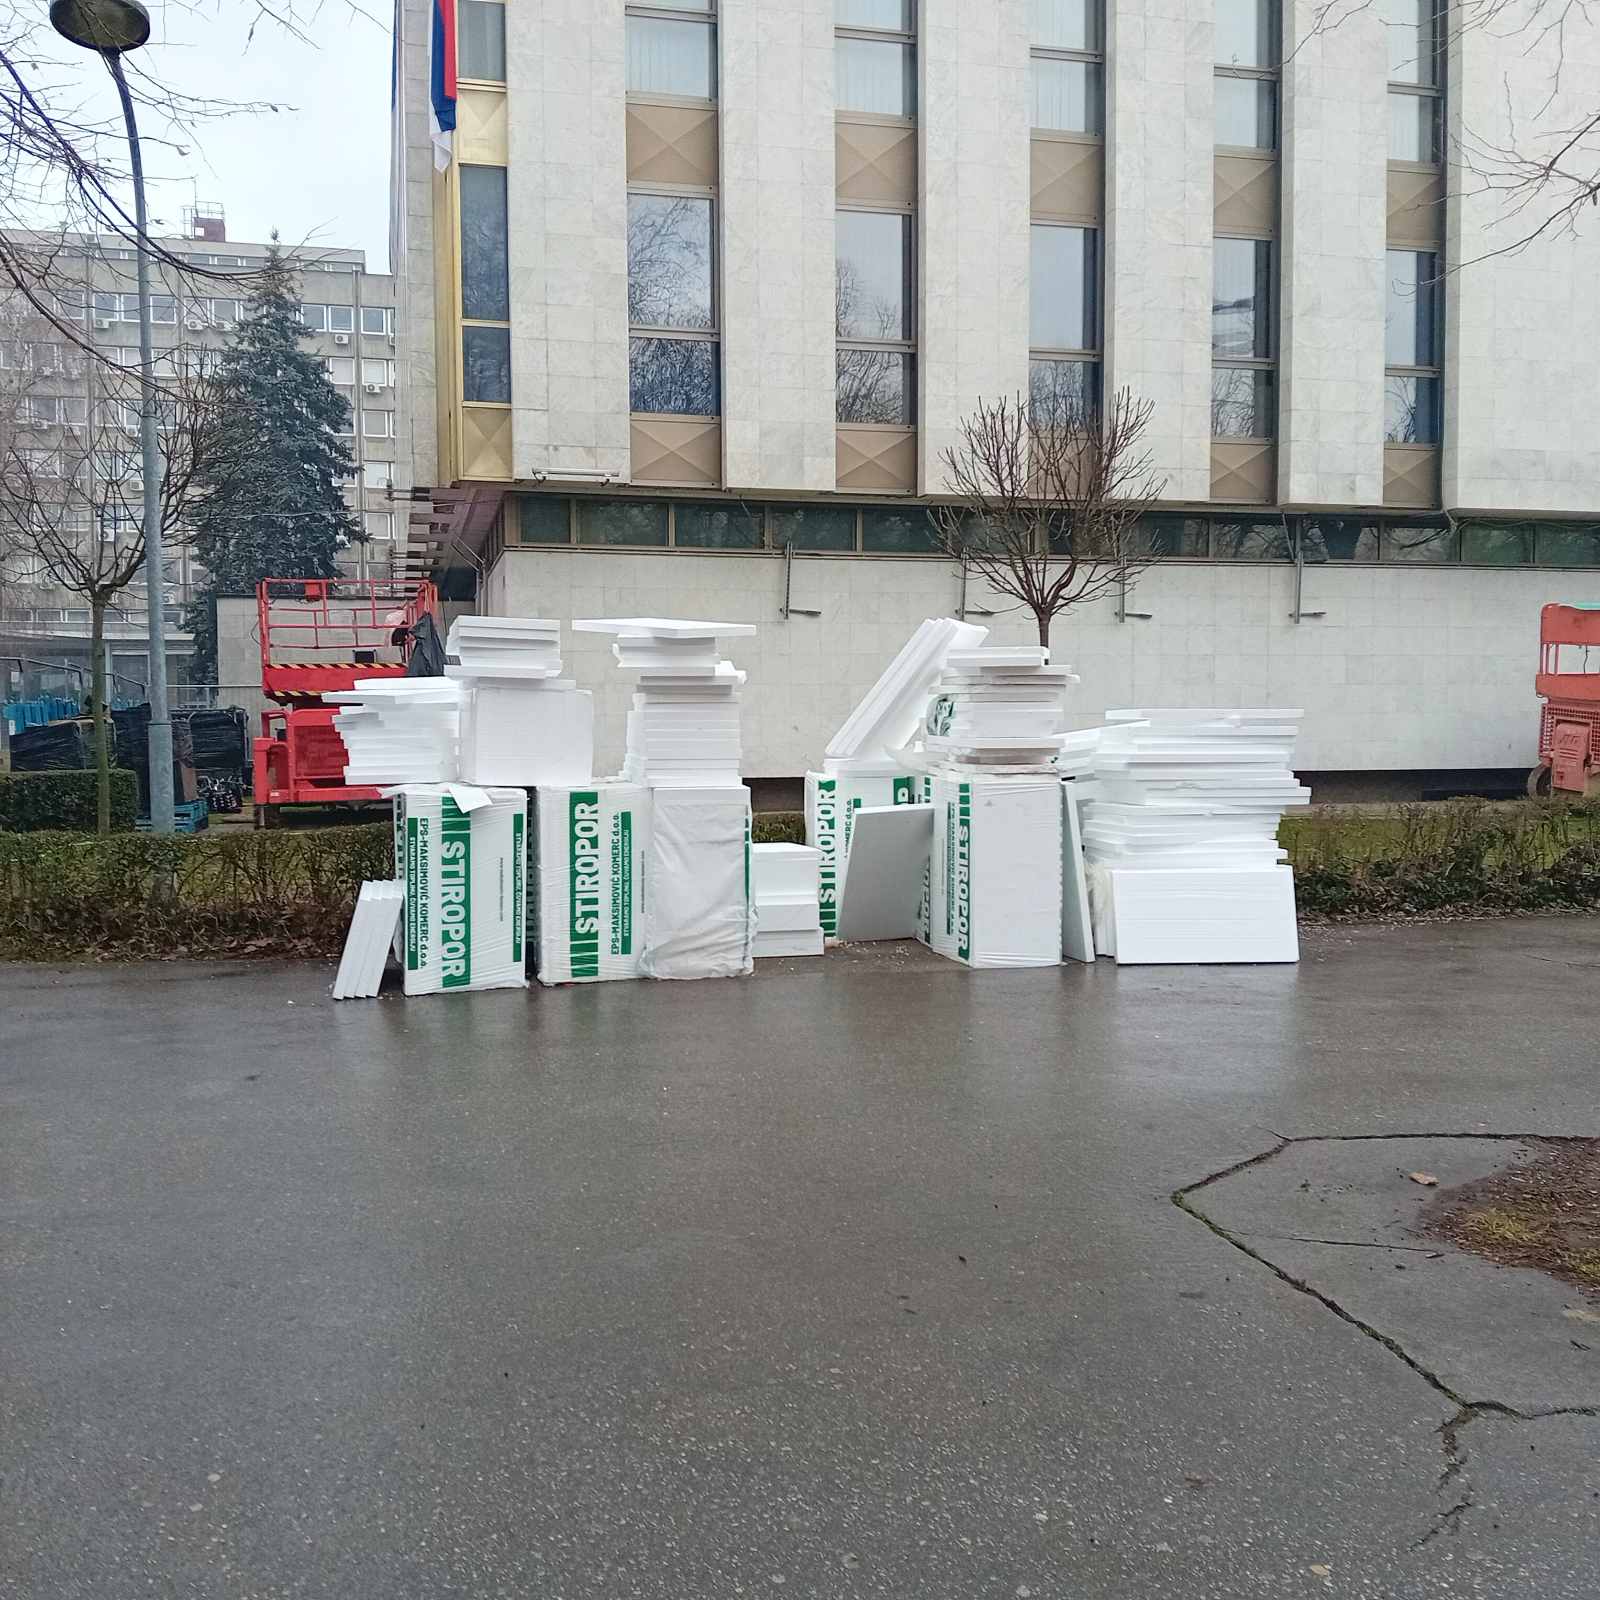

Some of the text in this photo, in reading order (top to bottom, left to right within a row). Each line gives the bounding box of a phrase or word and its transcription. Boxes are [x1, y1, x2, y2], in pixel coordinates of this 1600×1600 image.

[419, 818, 431, 969] EPS-MAKSIMOVIĆ KOMERC d.o.o.
[441, 841, 466, 977] STIROPOR
[574, 802, 599, 934] STIROPOR
[610, 813, 620, 955] EPS-MAKSIMOVIĆ KOMERC d.o.o.
[818, 789, 836, 903] STIROPOR
[958, 824, 970, 951] STIROPOR
